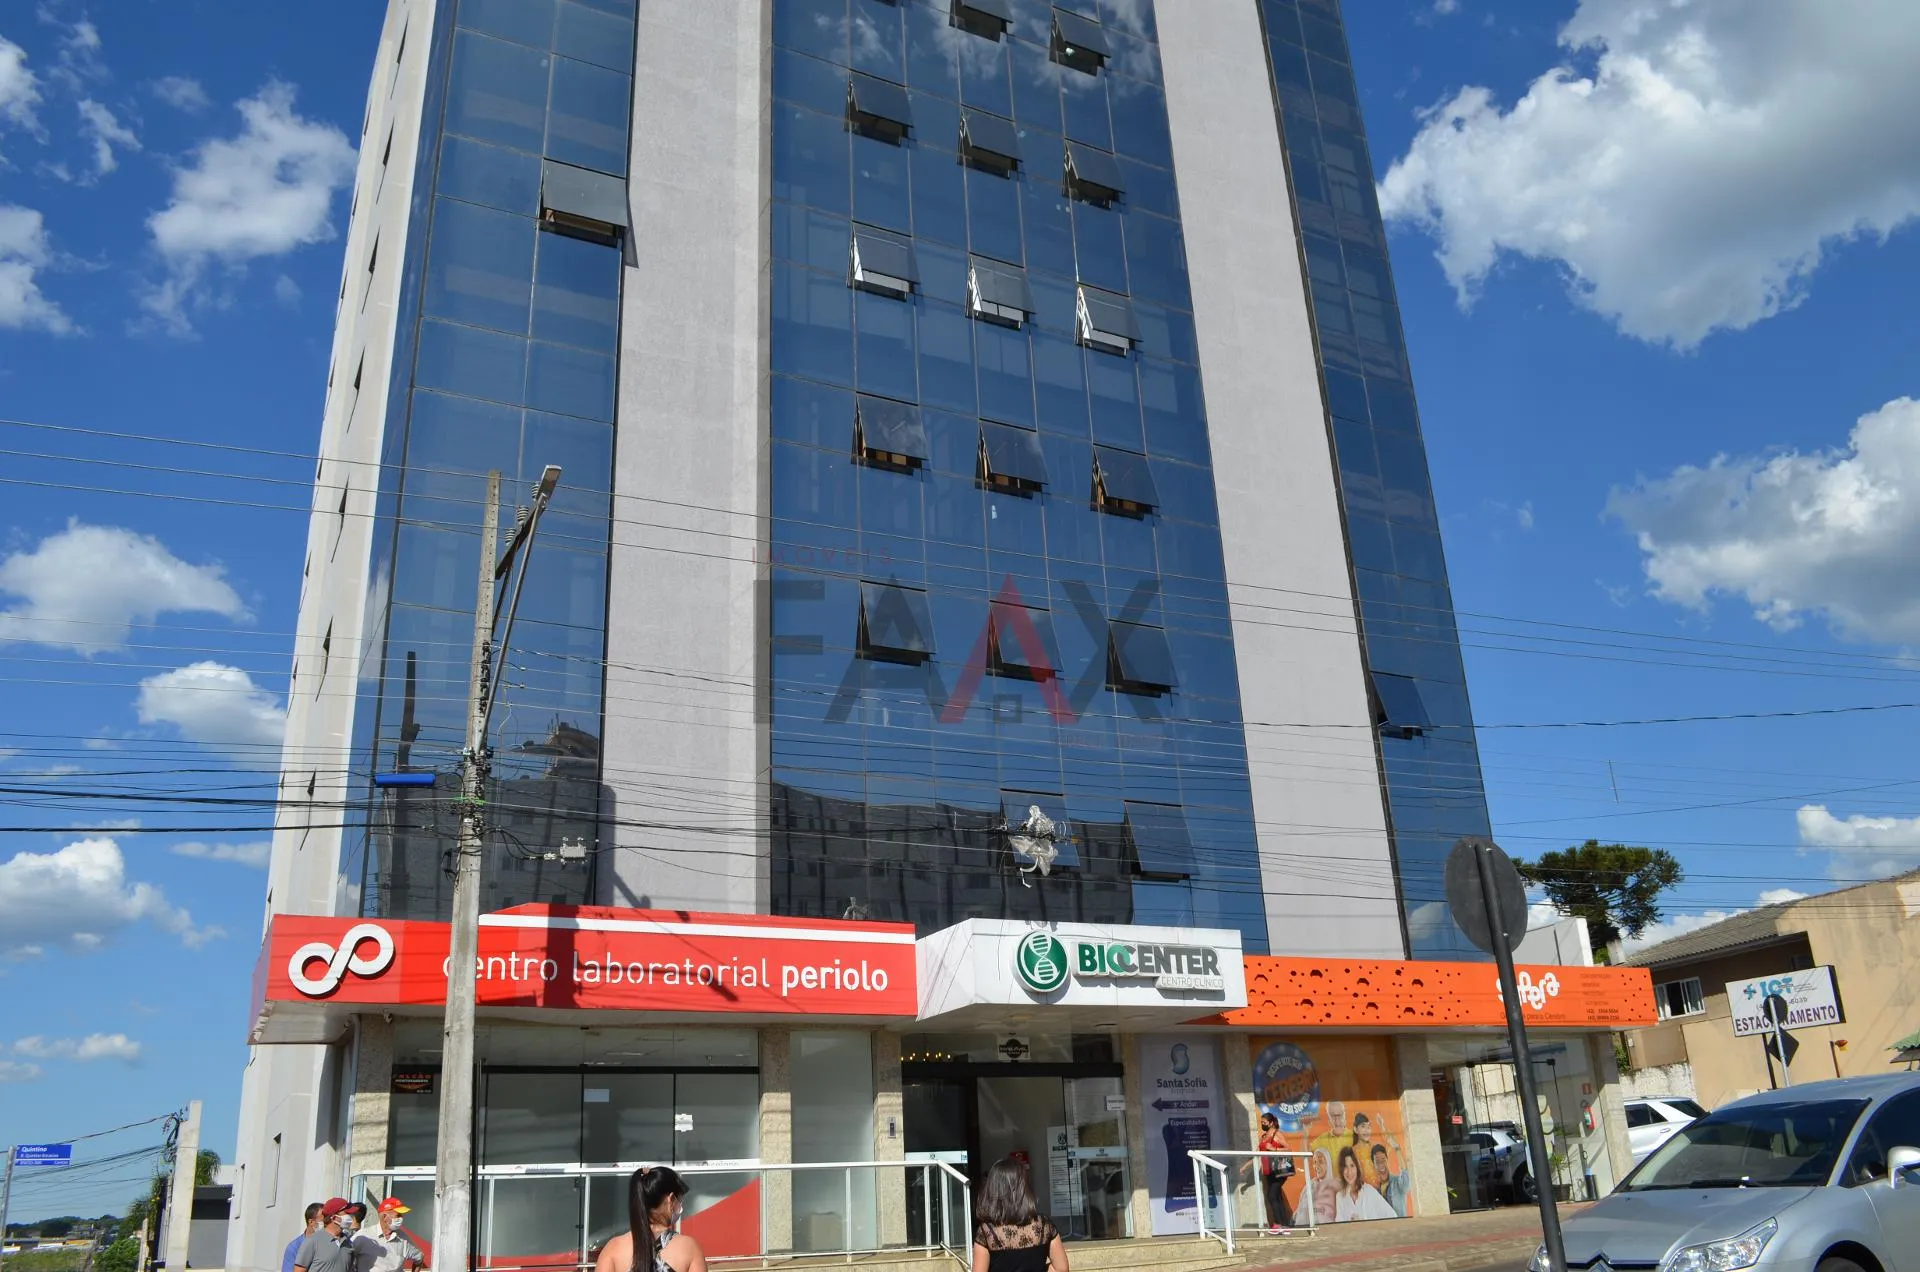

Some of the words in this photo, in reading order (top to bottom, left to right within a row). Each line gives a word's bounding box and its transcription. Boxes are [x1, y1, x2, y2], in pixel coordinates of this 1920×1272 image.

[1078, 943, 1221, 976] BIOCENTER
[573, 951, 770, 988] laboratorial
[782, 959, 889, 997] periolo
[1161, 975, 1193, 986] CENTRO
[1736, 1005, 1836, 1032] ESTACAMENTO
[1157, 1078, 1183, 1088] Santa
[1184, 1076, 1208, 1088] Sofia
